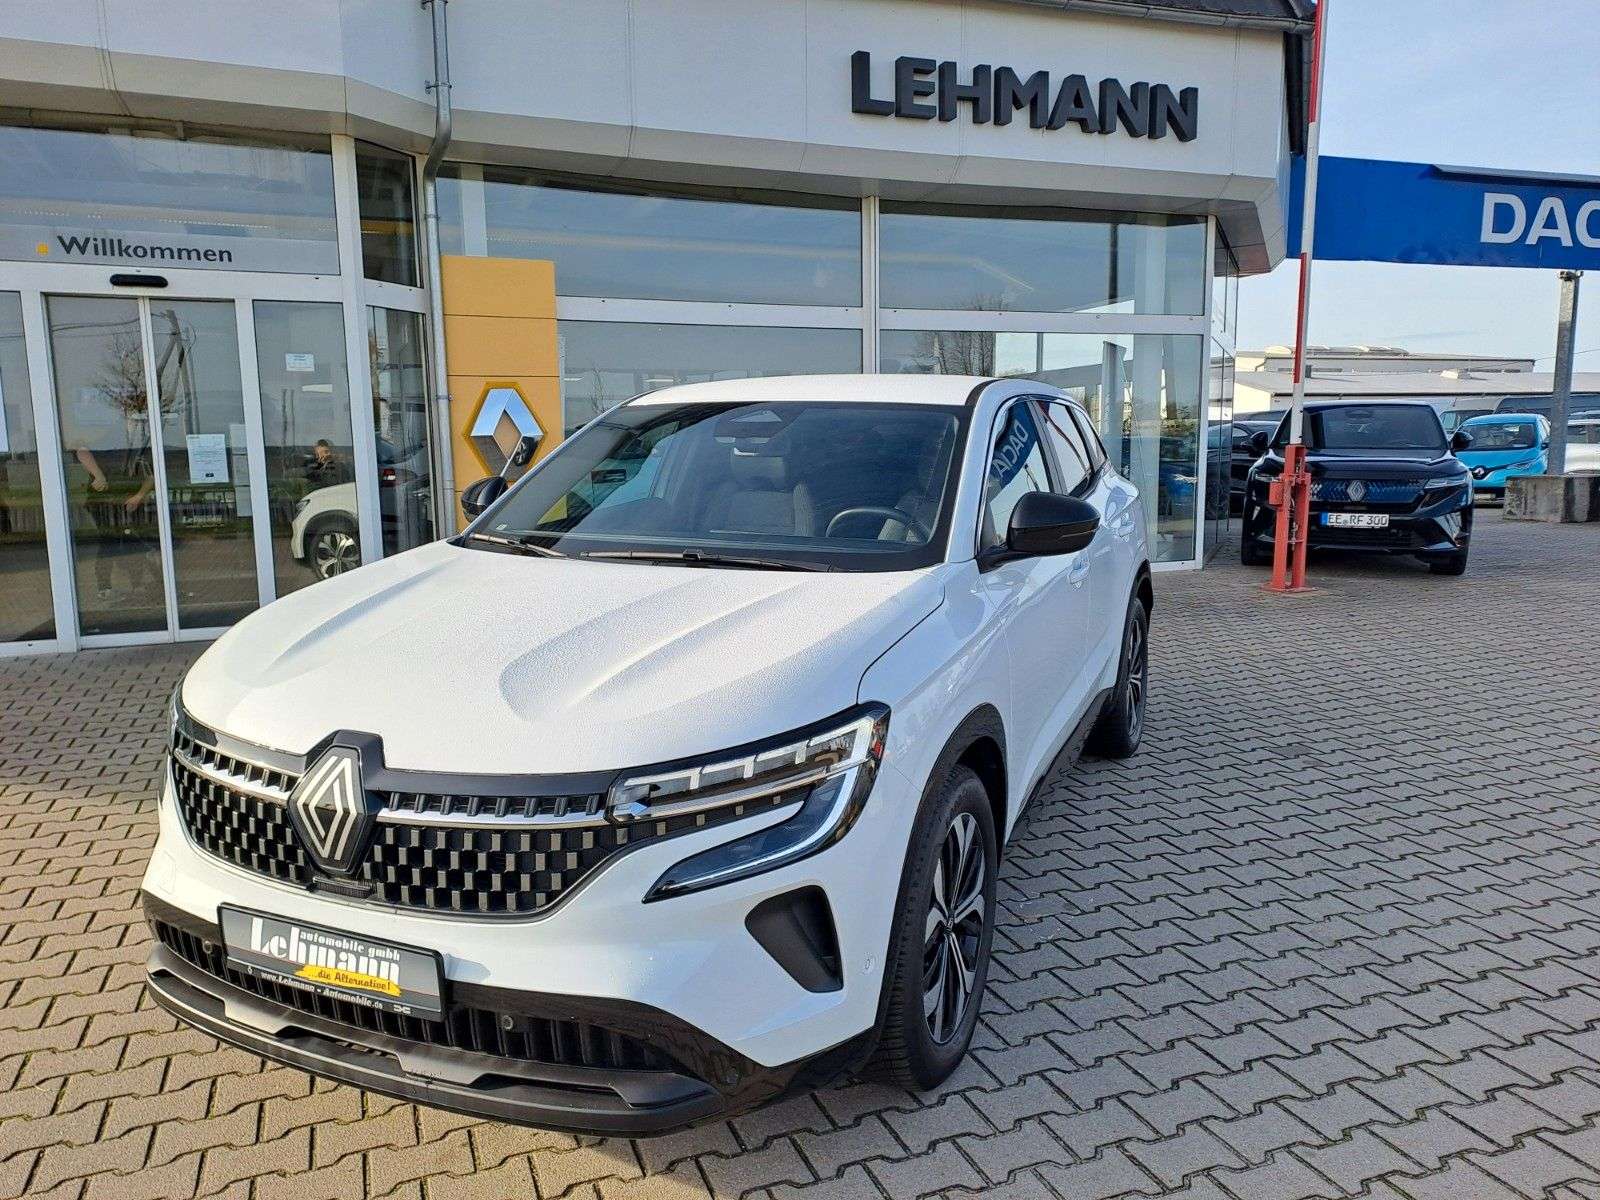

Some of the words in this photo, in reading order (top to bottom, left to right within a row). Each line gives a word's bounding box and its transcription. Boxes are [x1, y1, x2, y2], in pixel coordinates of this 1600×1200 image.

[851, 50, 1198, 142] LEHMANN
[57, 235, 233, 263] Willkommen
[1328, 514, 1342, 524] EE
[1350, 515, 1364, 524] RF
[1367, 516, 1387, 525] 300
[251, 917, 400, 985] Lehmann
[300, 931, 365, 953] automobile
[368, 947, 400, 961] gmbh
